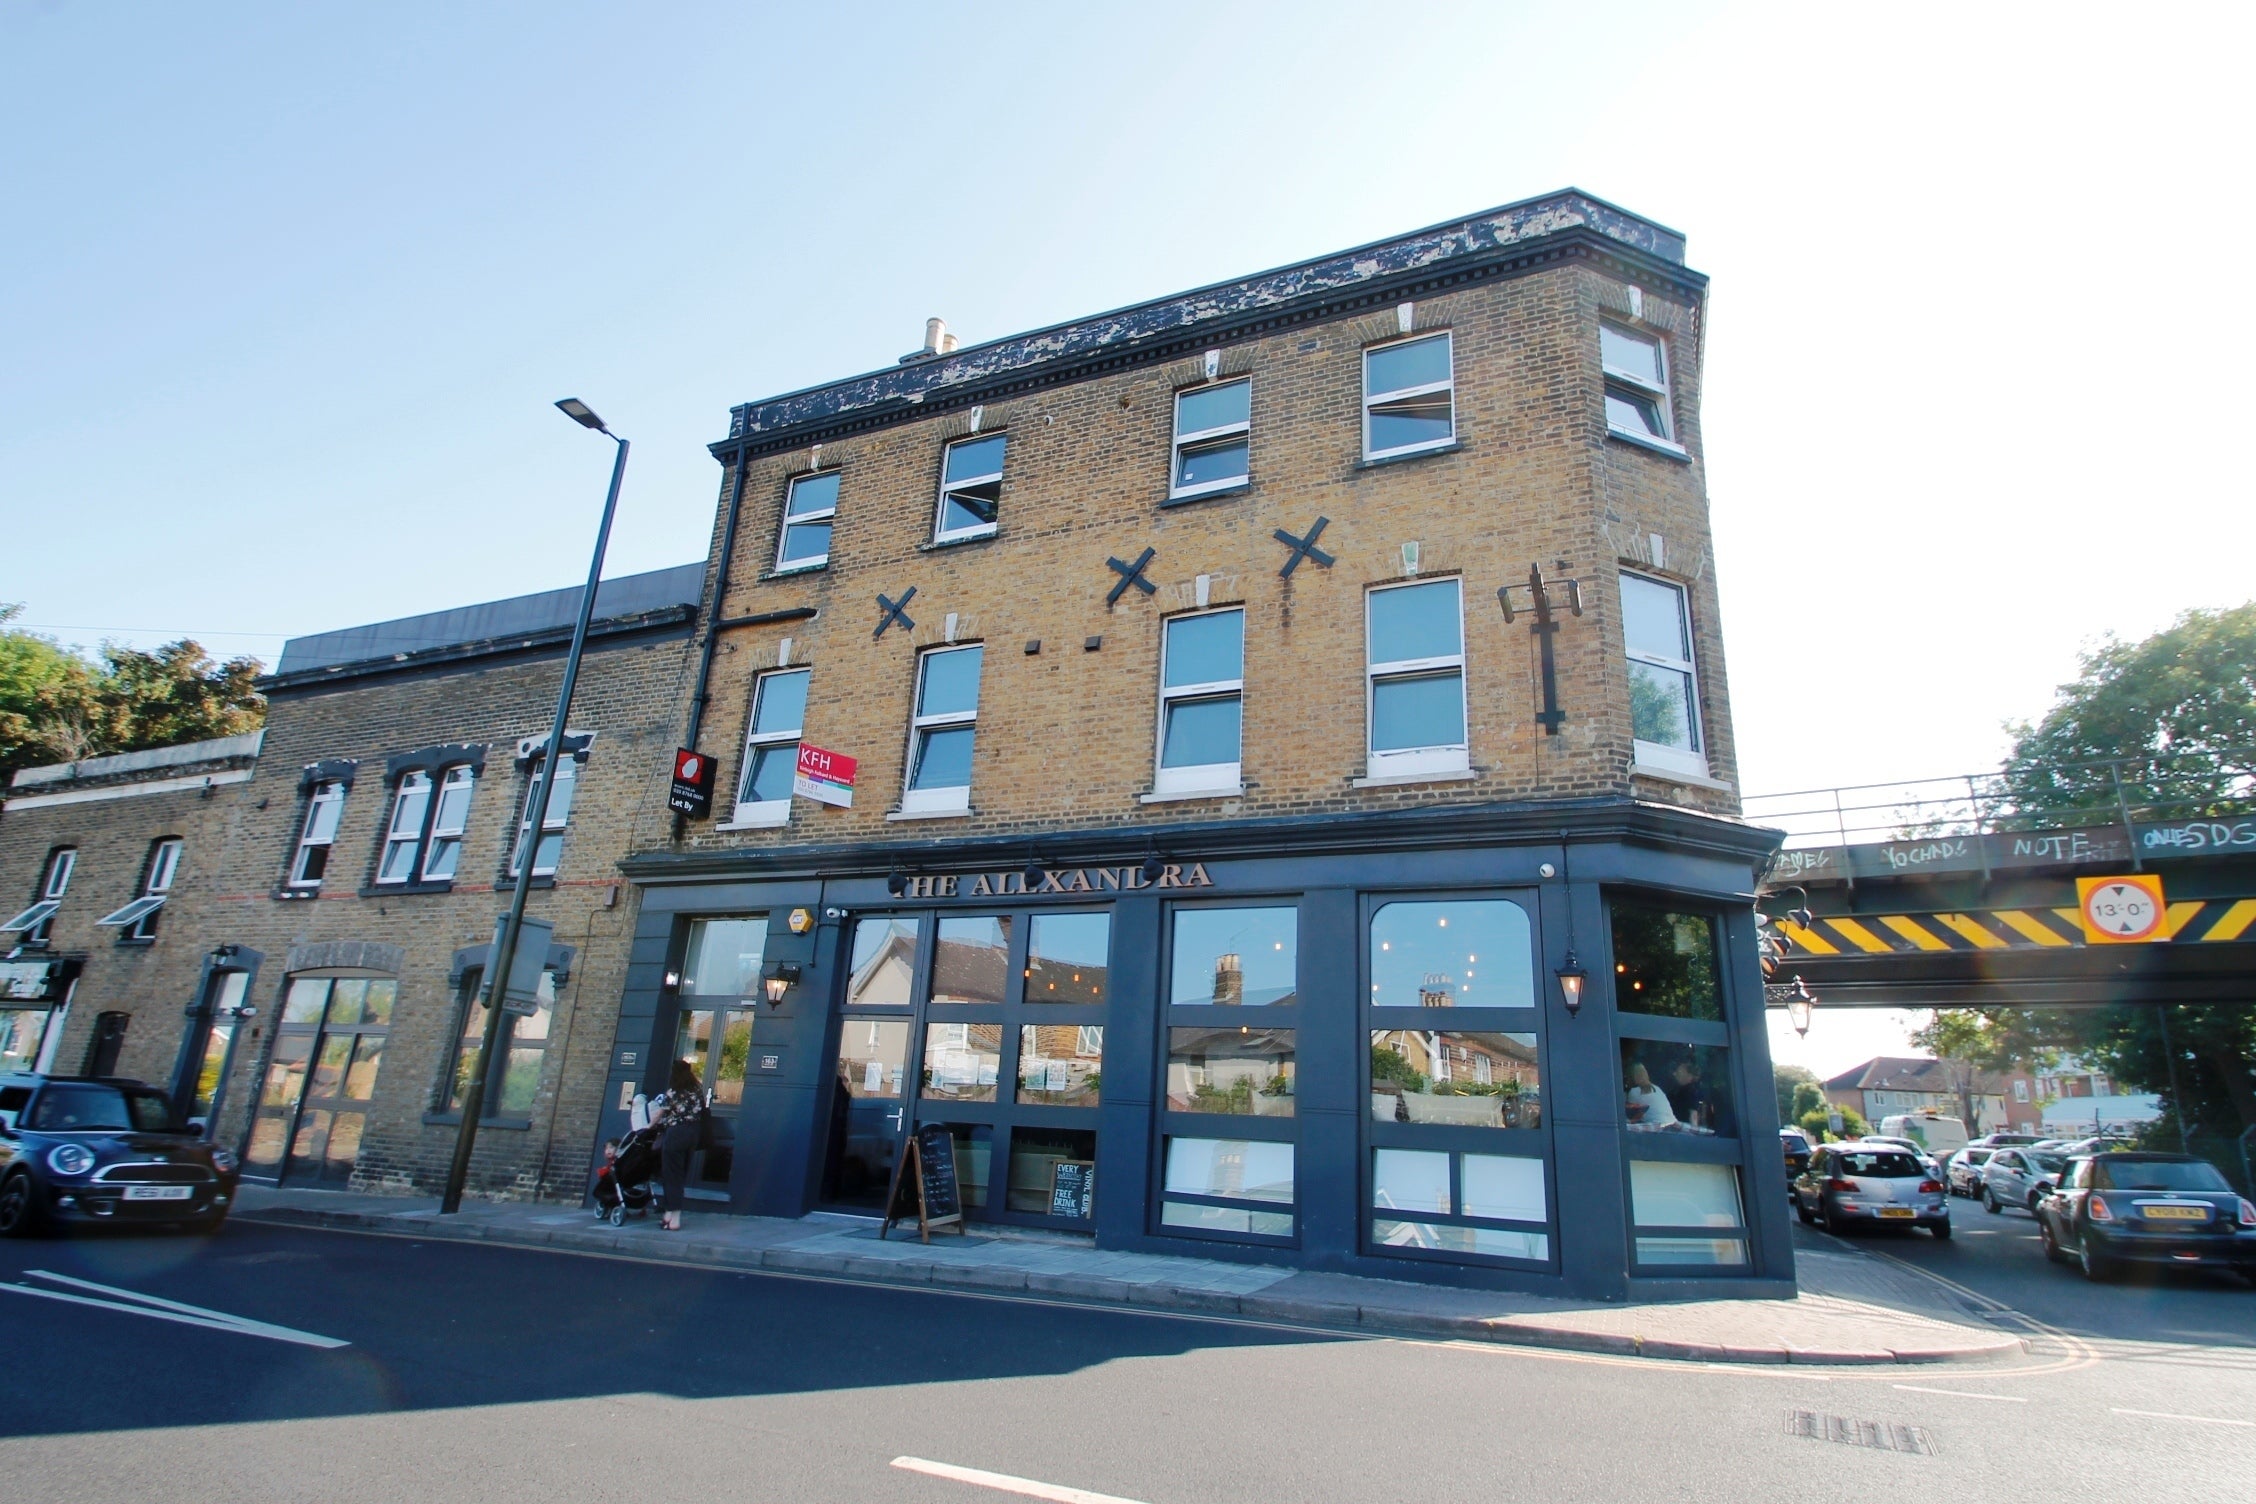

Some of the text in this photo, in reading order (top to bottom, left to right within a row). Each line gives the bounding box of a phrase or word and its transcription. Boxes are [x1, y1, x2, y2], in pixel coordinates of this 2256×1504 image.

[801, 748, 830, 771] KFH
[671, 798, 693, 812] Let By
[2014, 833, 2089, 860] NOTE
[892, 874, 958, 899] HE
[1057, 1164, 1079, 1174] EVERY
[1083, 1169, 1093, 1192] VINYL
[1053, 1197, 1077, 1208] DRINK
[1055, 1188, 1072, 1199] FREE
